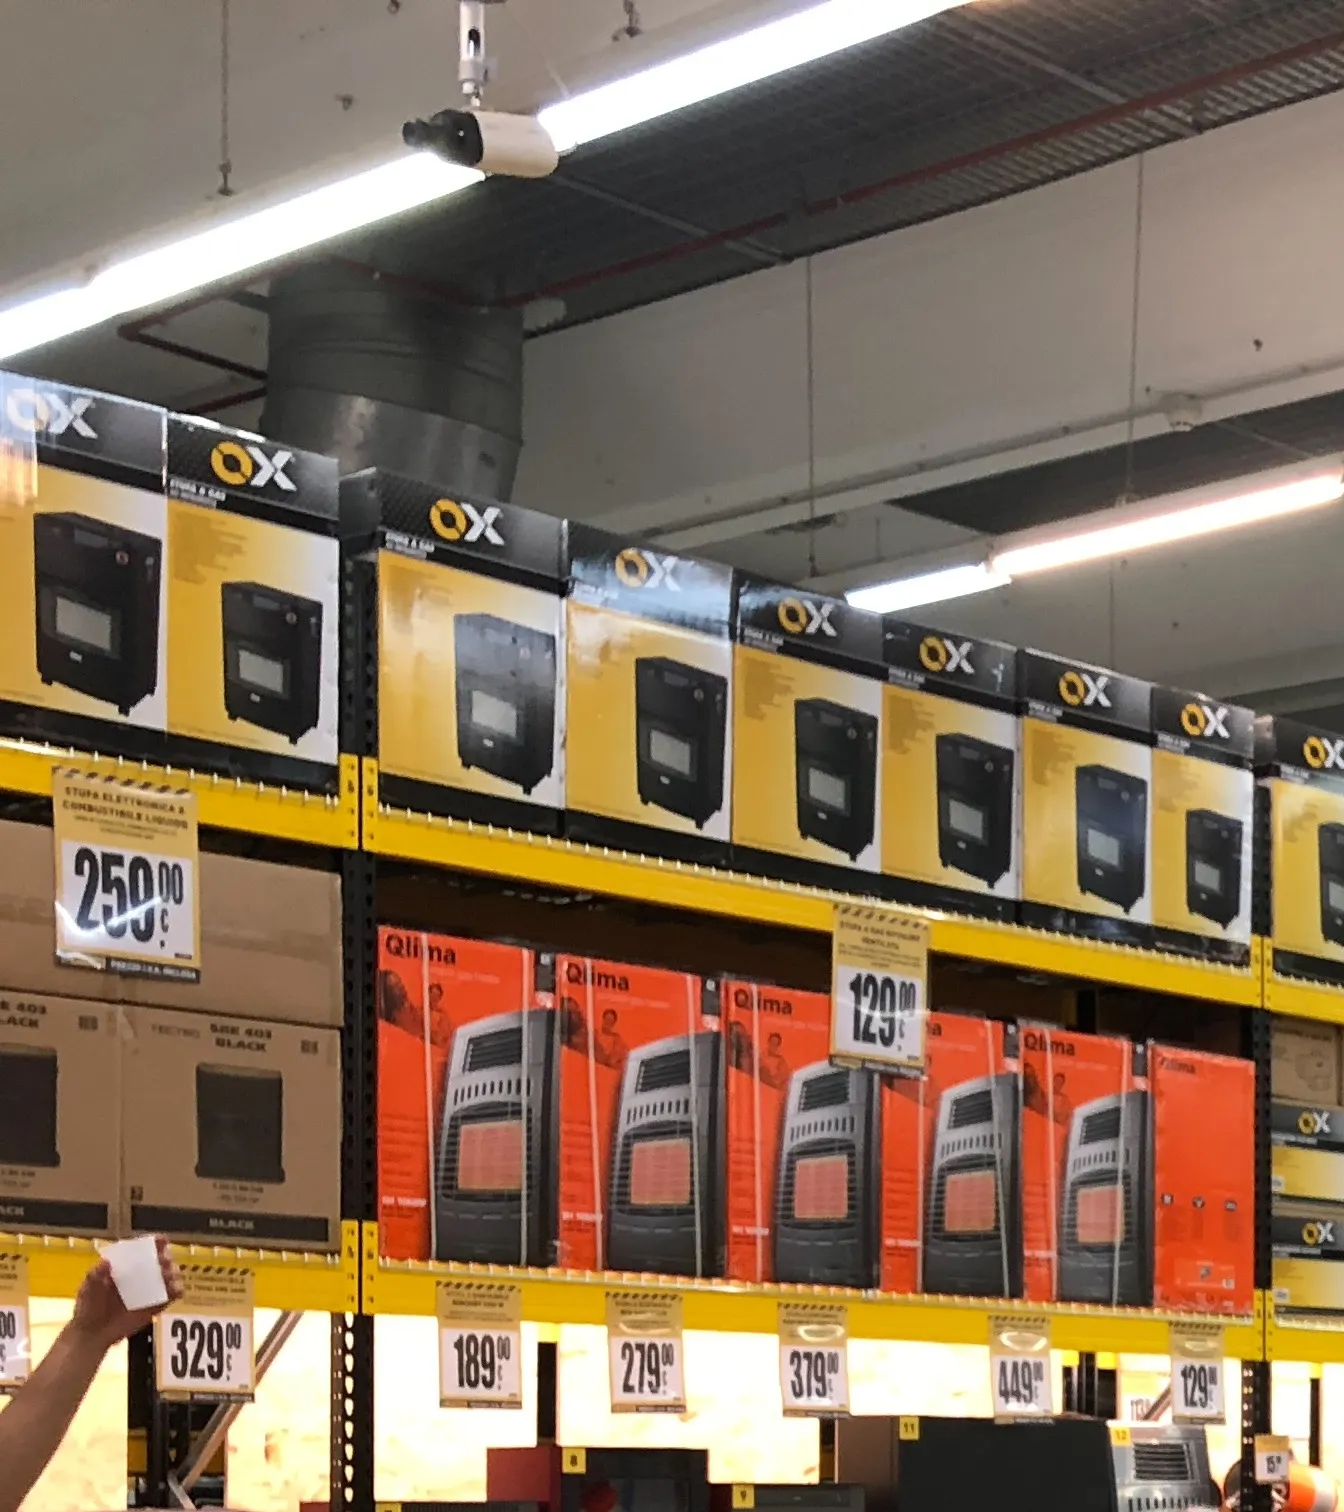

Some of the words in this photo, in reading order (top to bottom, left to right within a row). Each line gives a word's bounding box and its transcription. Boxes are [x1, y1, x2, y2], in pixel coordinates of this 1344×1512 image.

[6, 388, 98, 439] OX
[211, 440, 297, 492] OX
[430, 498, 505, 545] OX
[615, 547, 681, 591] OX
[778, 597, 839, 637] OX
[919, 635, 975, 675] OX
[1059, 670, 1112, 707] OX
[1181, 702, 1231, 738] OX
[385, 933, 456, 966] Qlima
[565, 962, 629, 993] Qlima
[734, 988, 793, 1016] Qlima
[849, 972, 896, 1048] 129
[1024, 1031, 1076, 1058] Qlima
[1298, 1111, 1331, 1135] OX
[1302, 1221, 1335, 1246] OX
[170, 1319, 224, 1380] 329
[453, 1333, 495, 1390] 189
[621, 1341, 661, 1394] 279
[789, 1349, 827, 1400] 379
[999, 1360, 1033, 1404] 449
[1180, 1364, 1208, 1409] 129
[902, 1422, 916, 1434] 11
[1114, 1429, 1128, 1441] 12
